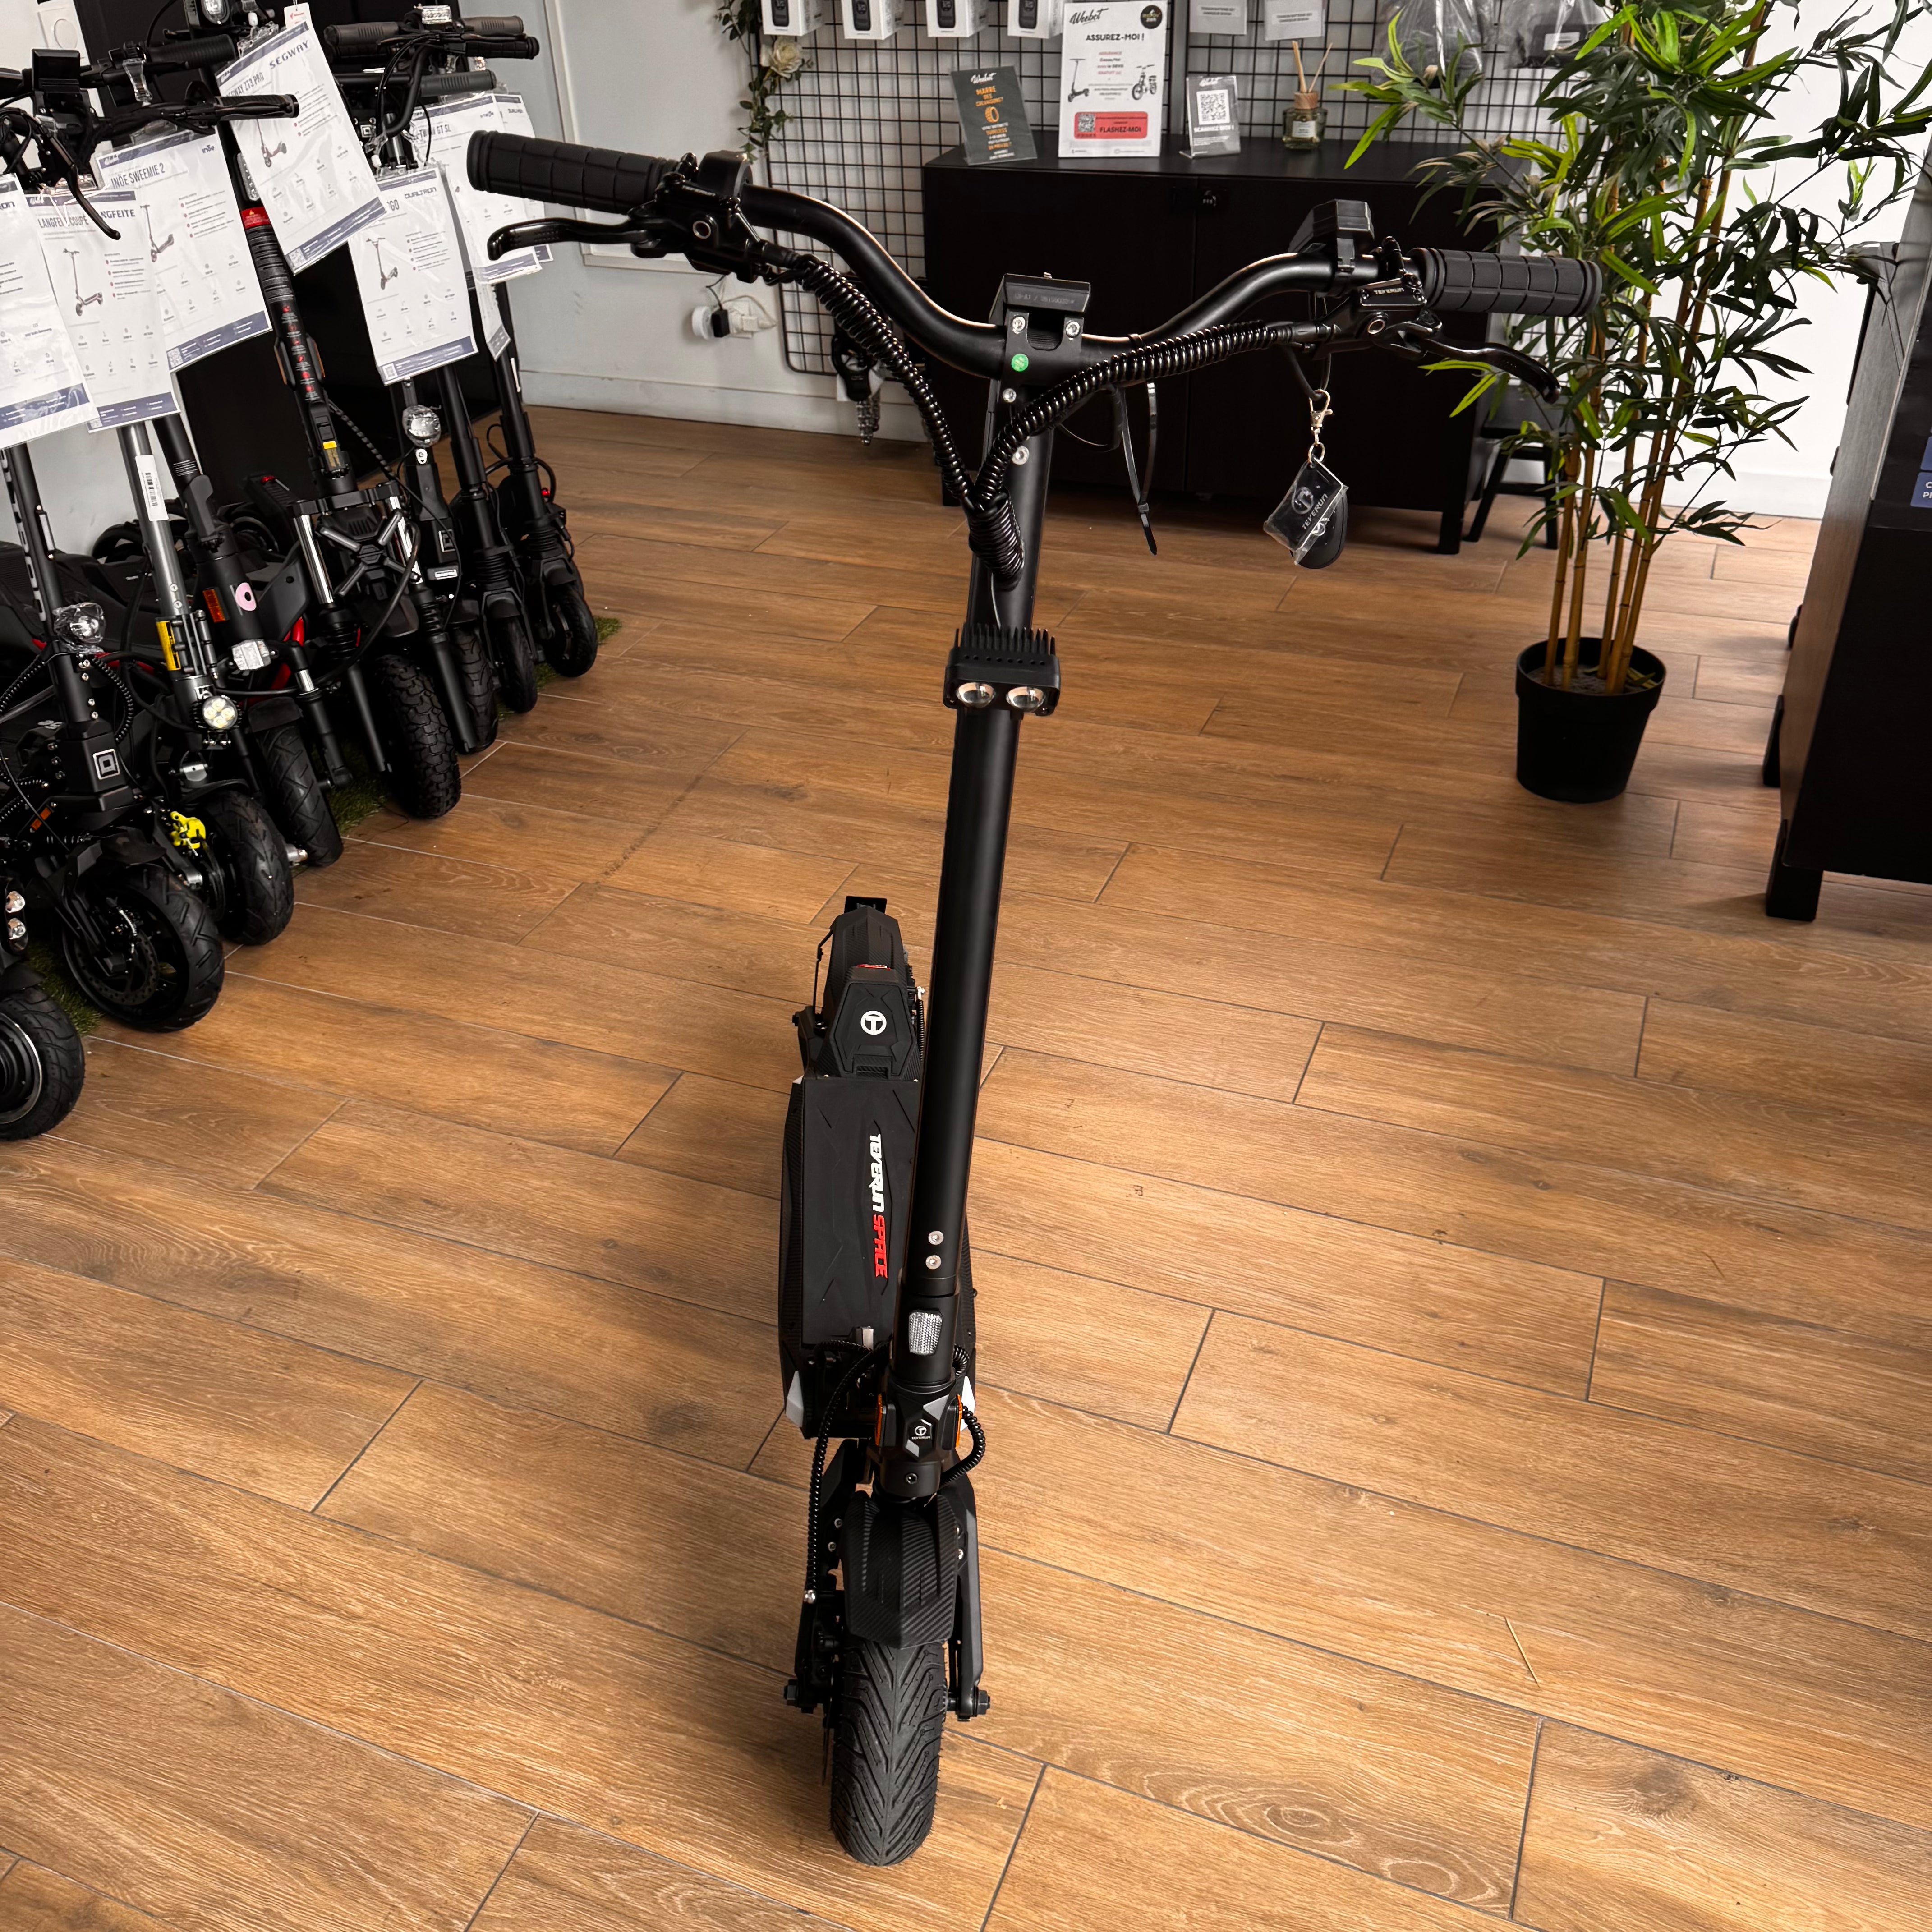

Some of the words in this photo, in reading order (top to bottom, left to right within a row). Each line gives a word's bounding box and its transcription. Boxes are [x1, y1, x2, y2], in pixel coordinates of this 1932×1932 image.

[269, 40, 309, 69] SEGWAY
[226, 84, 244, 97] GWAY
[253, 72, 264, 85] PRO
[111, 174, 128, 189] INÖE
[130, 166, 160, 184] SWEEMIE
[159, 163, 165, 174] 2
[101, 209, 135, 218] NGFEITE
[387, 200, 399, 211] GO
[1302, 493, 1328, 529] TEVERUN
[869, 1133, 884, 1213] TEVERUN
[873, 1214, 888, 1279] SPACE
